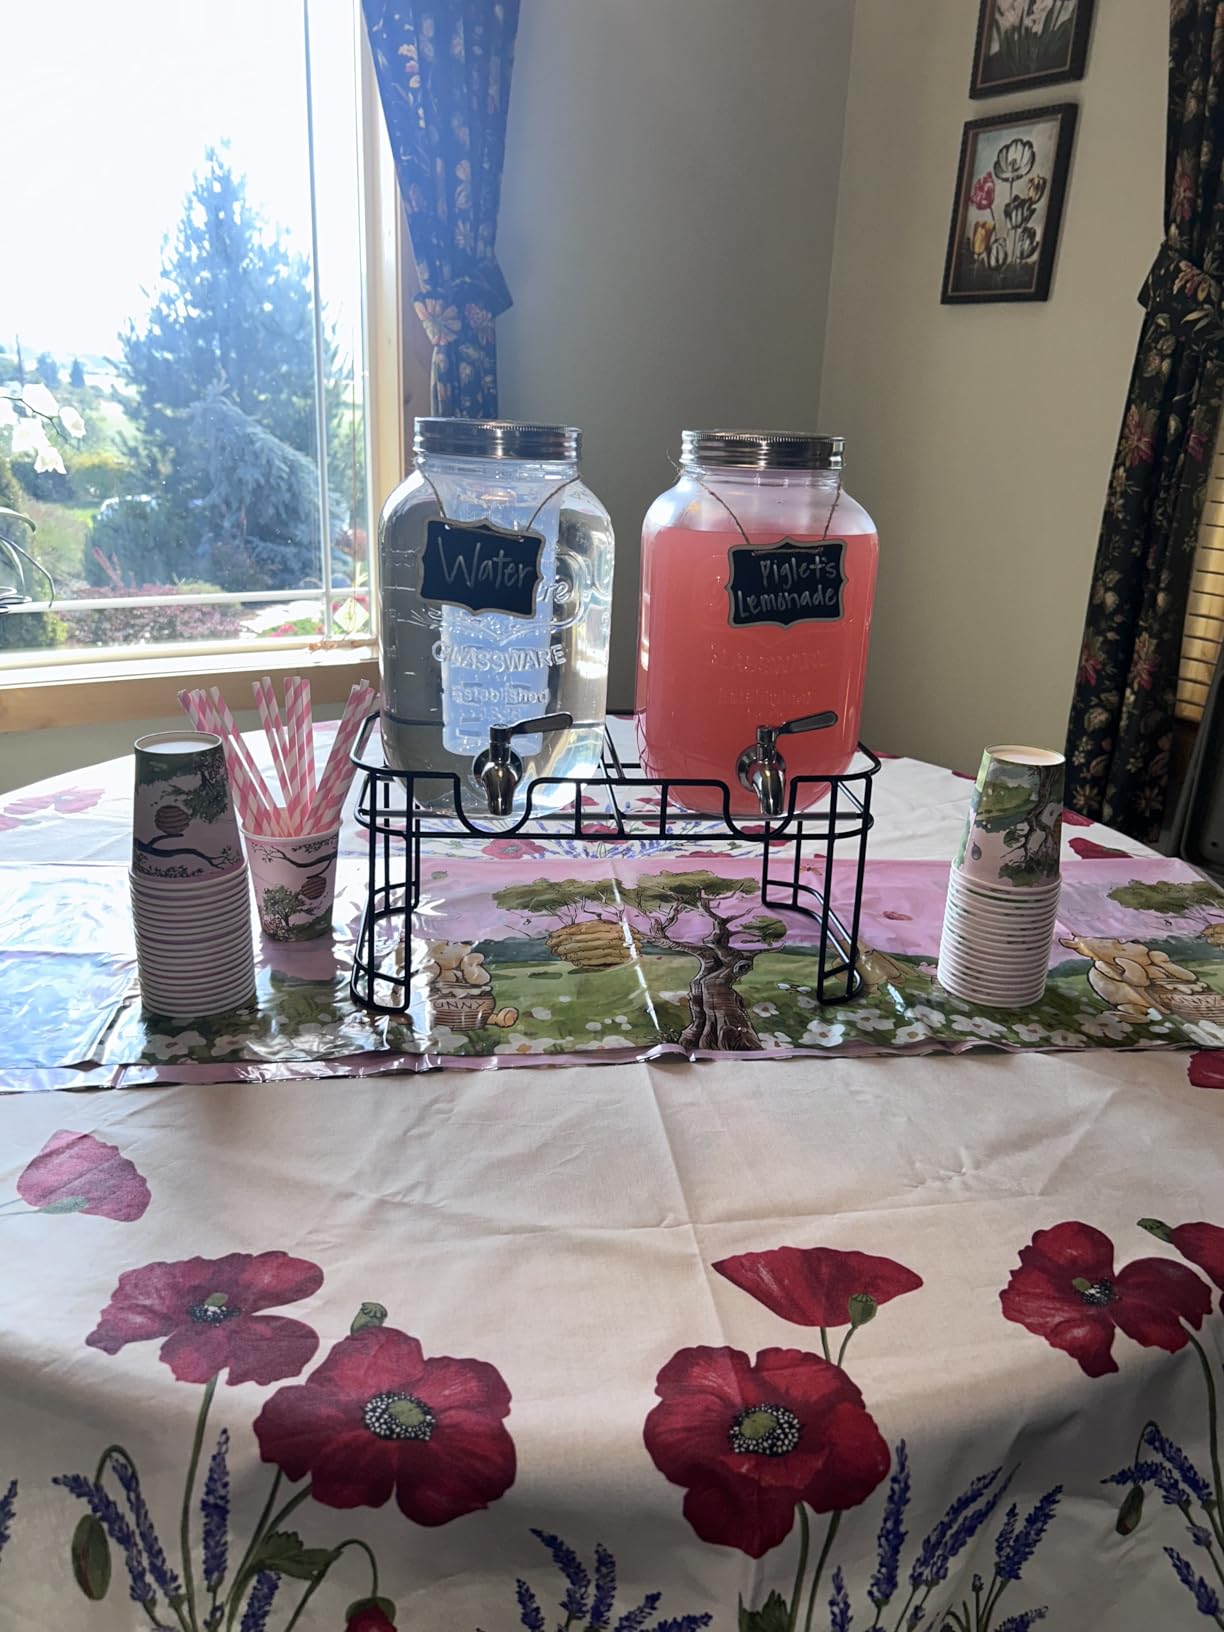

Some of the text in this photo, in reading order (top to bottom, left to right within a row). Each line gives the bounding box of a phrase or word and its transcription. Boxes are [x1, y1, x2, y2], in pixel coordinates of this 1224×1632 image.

[437, 536, 534, 589] Water
[760, 555, 837, 590] Piglet's
[737, 584, 837, 618] Lemonade
[432, 641, 567, 672] GLASSWARE
[433, 1000, 486, 1010] UNNY
